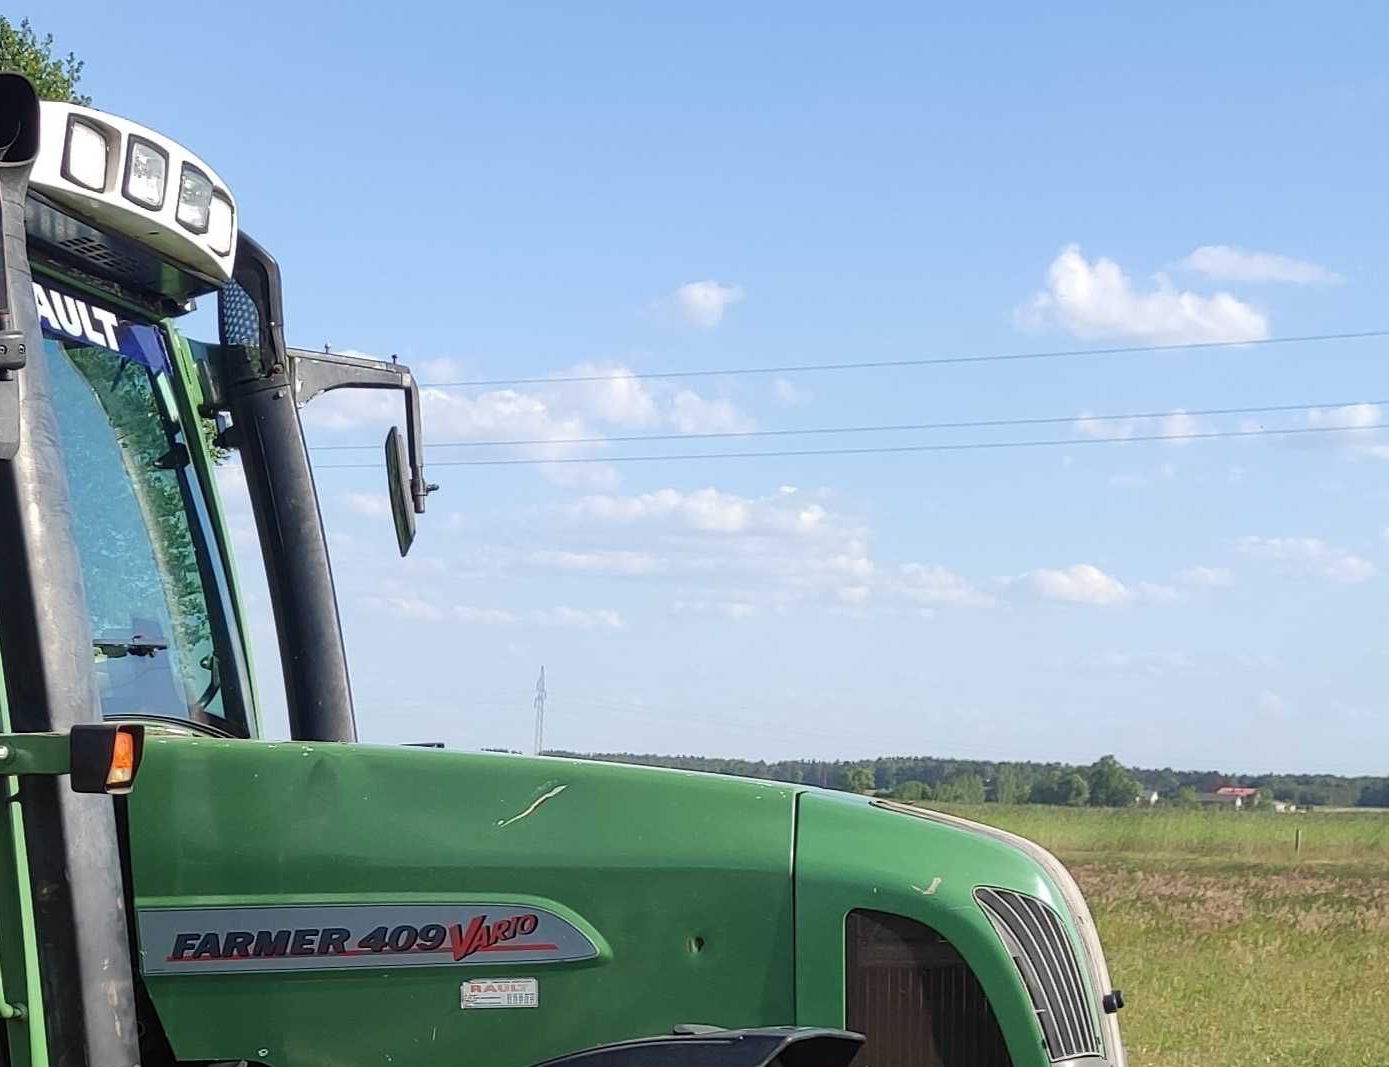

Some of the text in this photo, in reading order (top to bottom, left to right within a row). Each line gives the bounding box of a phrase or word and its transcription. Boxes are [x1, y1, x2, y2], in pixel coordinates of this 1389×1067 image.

[172, 928, 351, 959] FARMER
[358, 924, 447, 953] 409
[470, 984, 530, 993] RAULT
